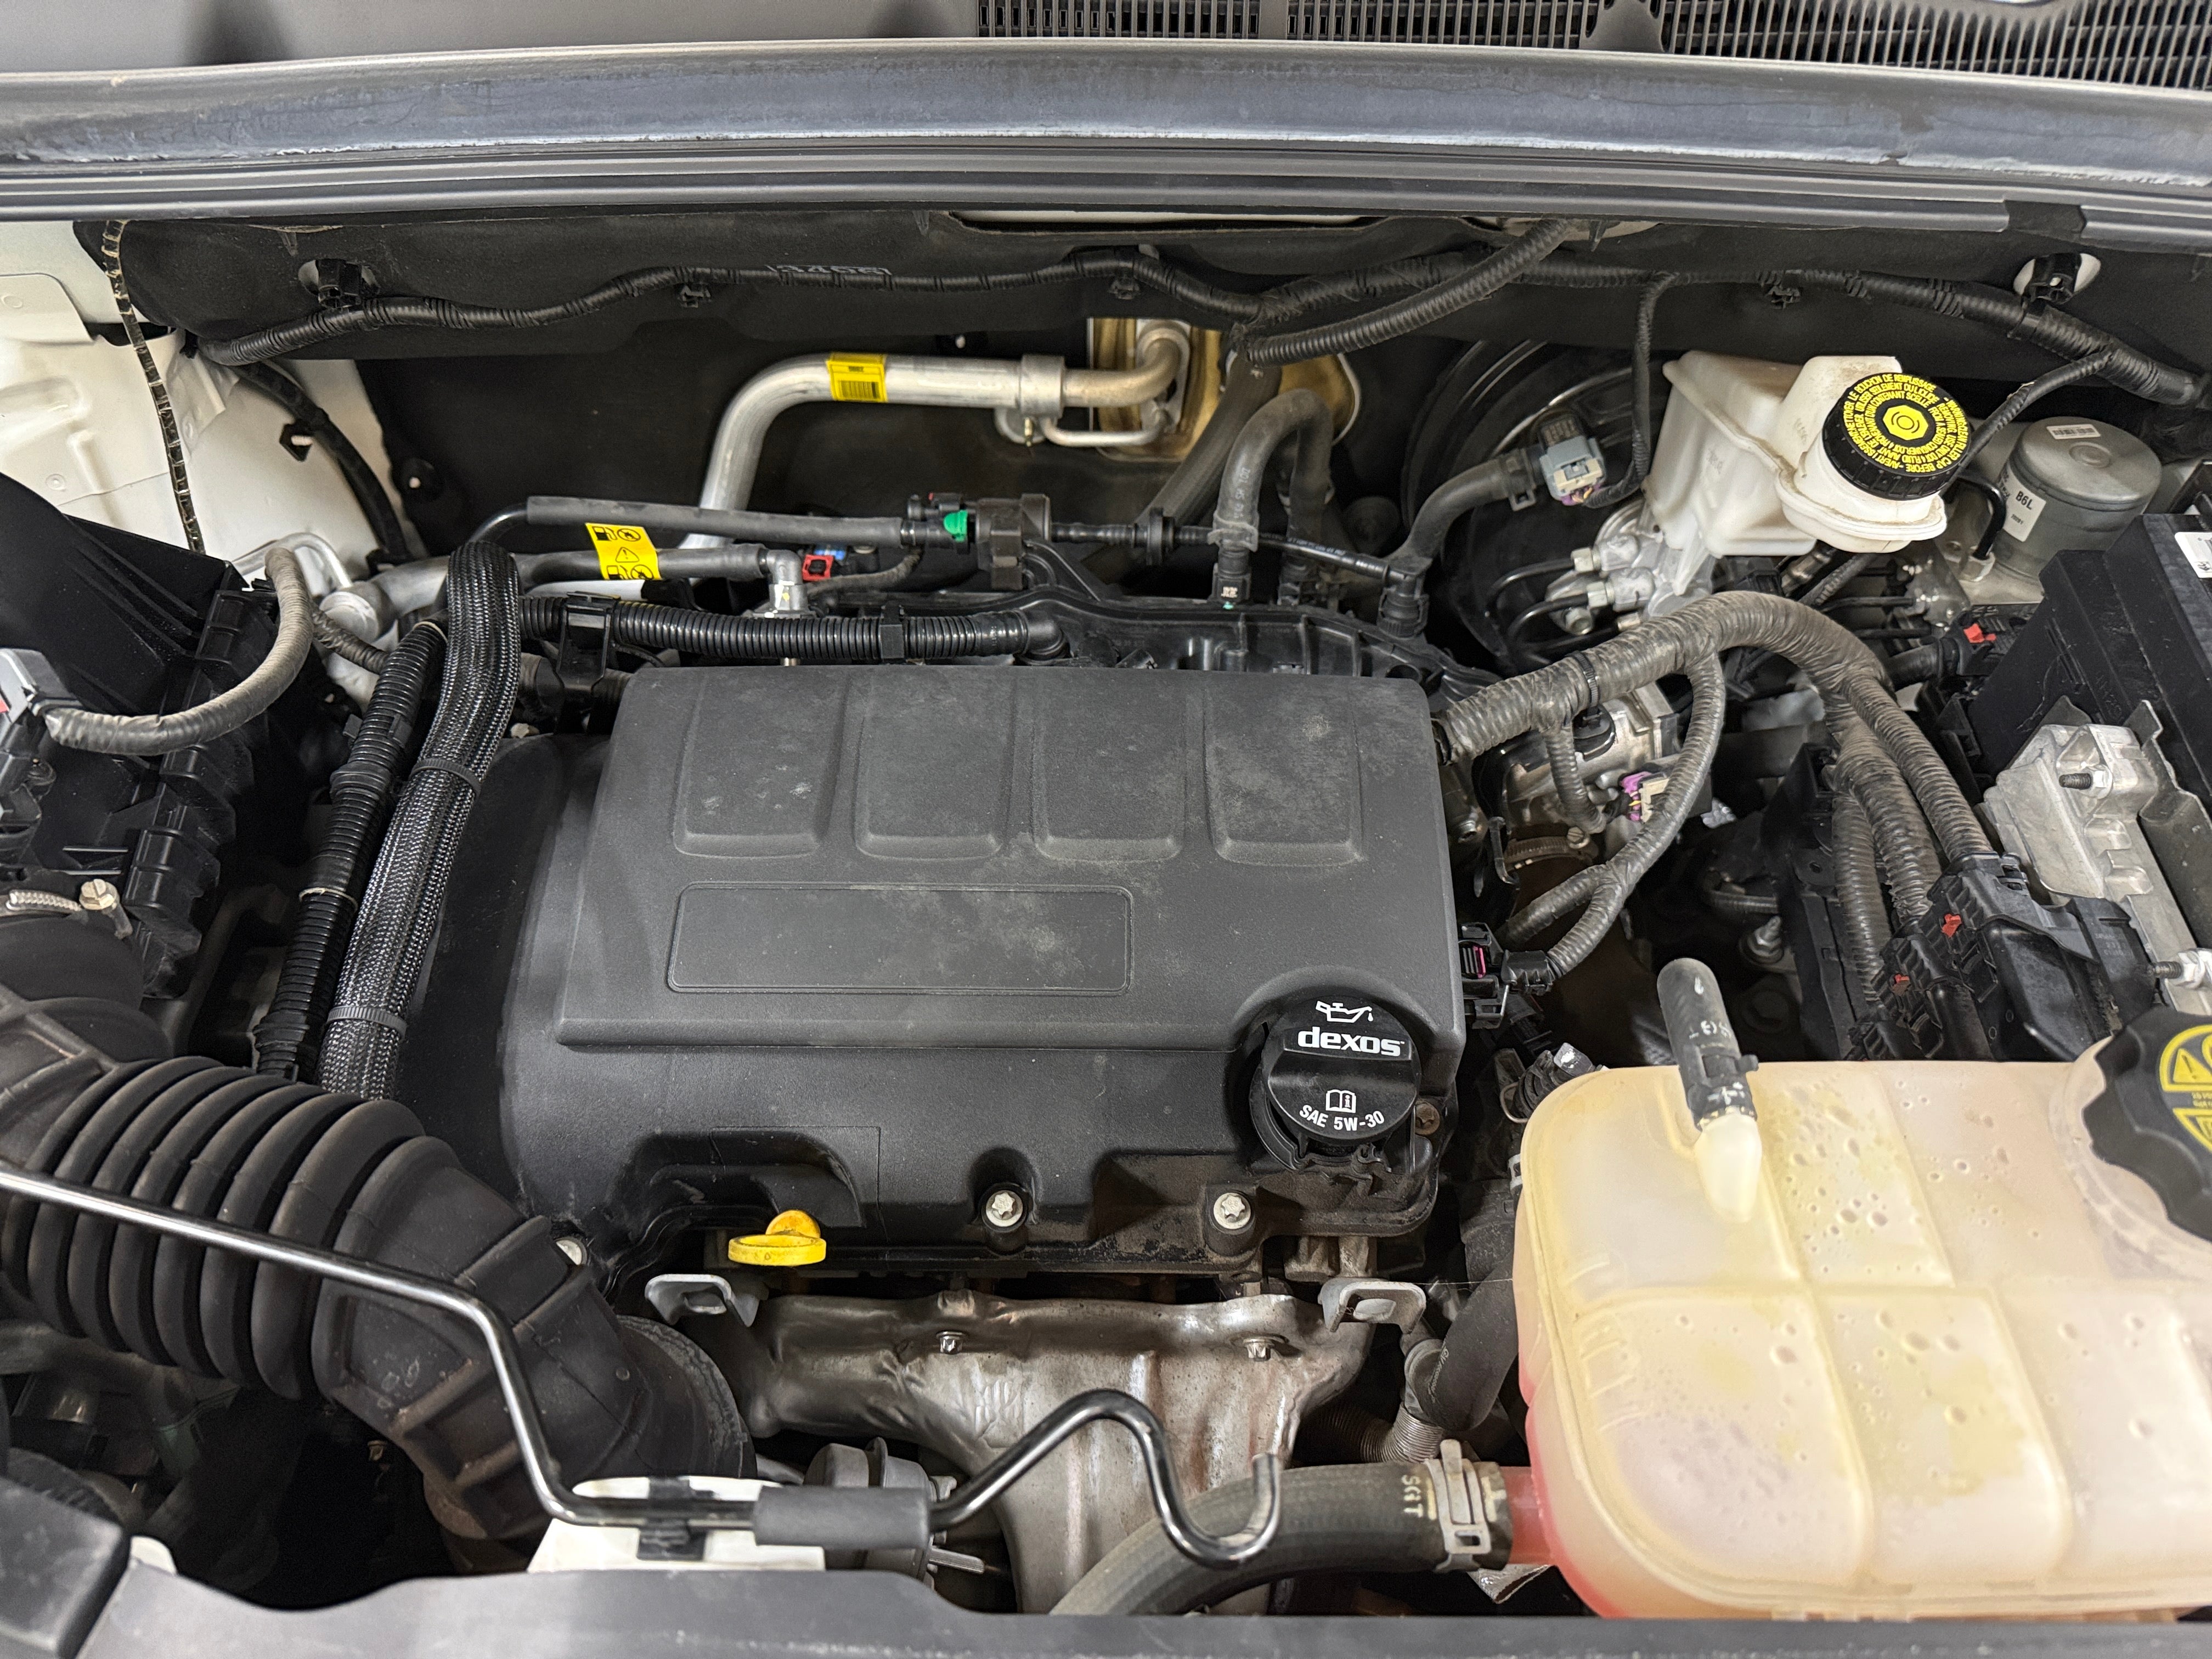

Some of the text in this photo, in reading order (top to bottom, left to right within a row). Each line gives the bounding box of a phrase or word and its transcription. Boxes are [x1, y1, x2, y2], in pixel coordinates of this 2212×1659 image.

[1848, 391, 1859, 400] LE
[1854, 376, 1883, 393] BOUCHON
[1882, 374, 1893, 382] DE
[1894, 374, 1936, 392] REMPLISSAGE
[1904, 383, 1915, 392] DU
[1870, 391, 1905, 407] CONTENANT
[1914, 385, 1939, 403] LIQUIDE
[1928, 407, 1944, 421] FROM
[1932, 426, 1946, 444] SEALED
[1943, 435, 1956, 448] USE
[1867, 438, 1879, 448] DE
[1877, 447, 1900, 460] AVANT
[1925, 452, 1938, 462] DOT
[1935, 445, 1950, 458] ONLY
[1947, 441, 1966, 460] FILLER
[1901, 455, 1922, 464] FLUID
[1937, 457, 1951, 469] CAP
[1906, 463, 1936, 472] BEFORE
[2016, 490, 2033, 510] B6L
[1297, 1026, 1402, 1057] dexos
[1299, 1104, 1385, 1131] SAE 5W-30
